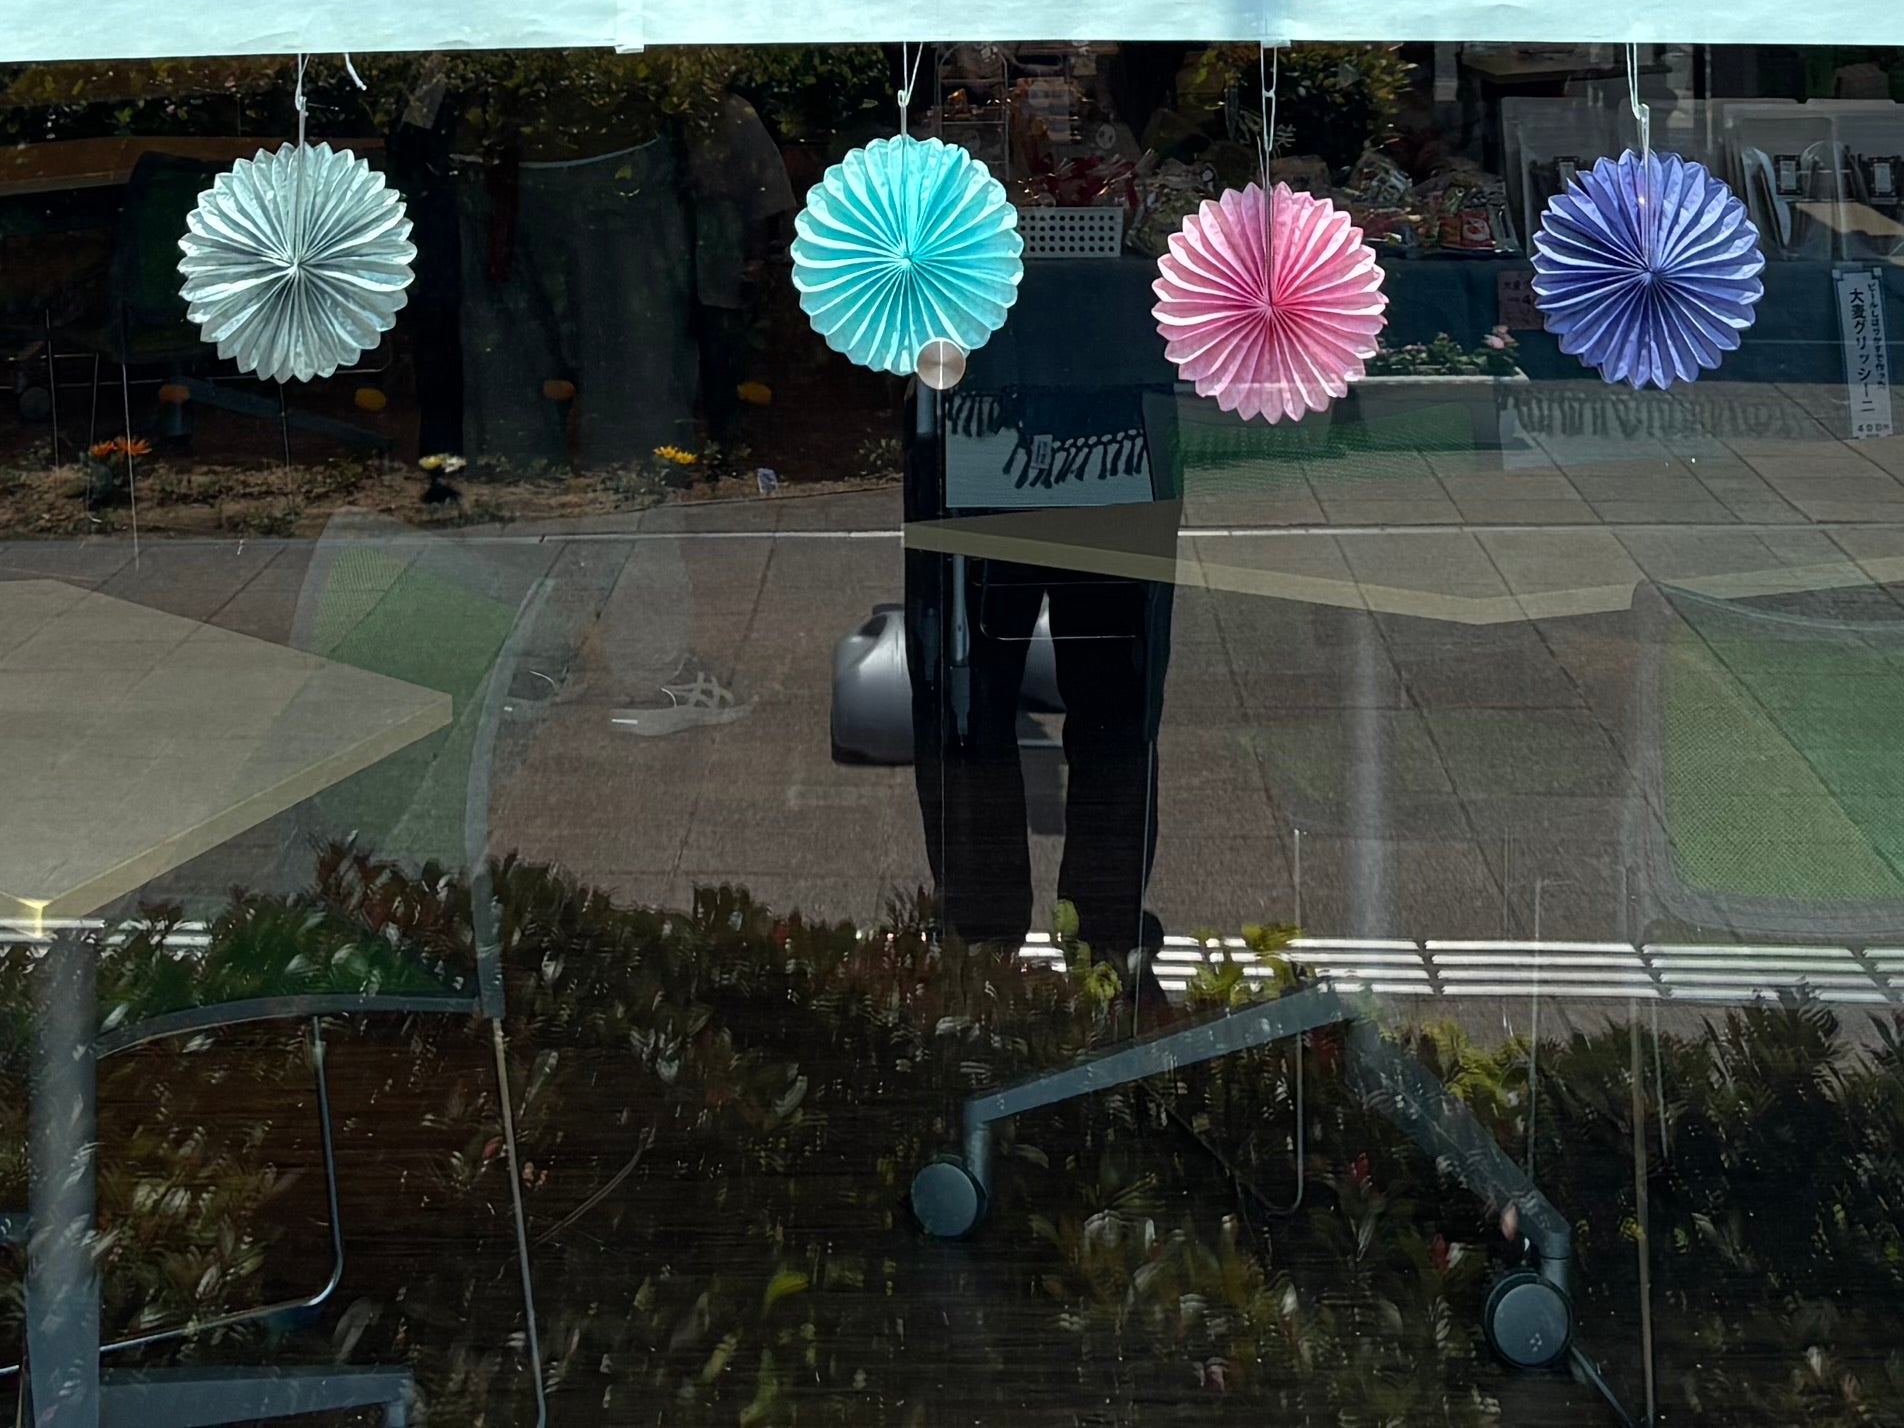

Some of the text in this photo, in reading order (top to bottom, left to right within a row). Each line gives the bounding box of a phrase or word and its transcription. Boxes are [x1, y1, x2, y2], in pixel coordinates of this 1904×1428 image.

[1849, 287, 1876, 413] 大麦グリッシーニ
